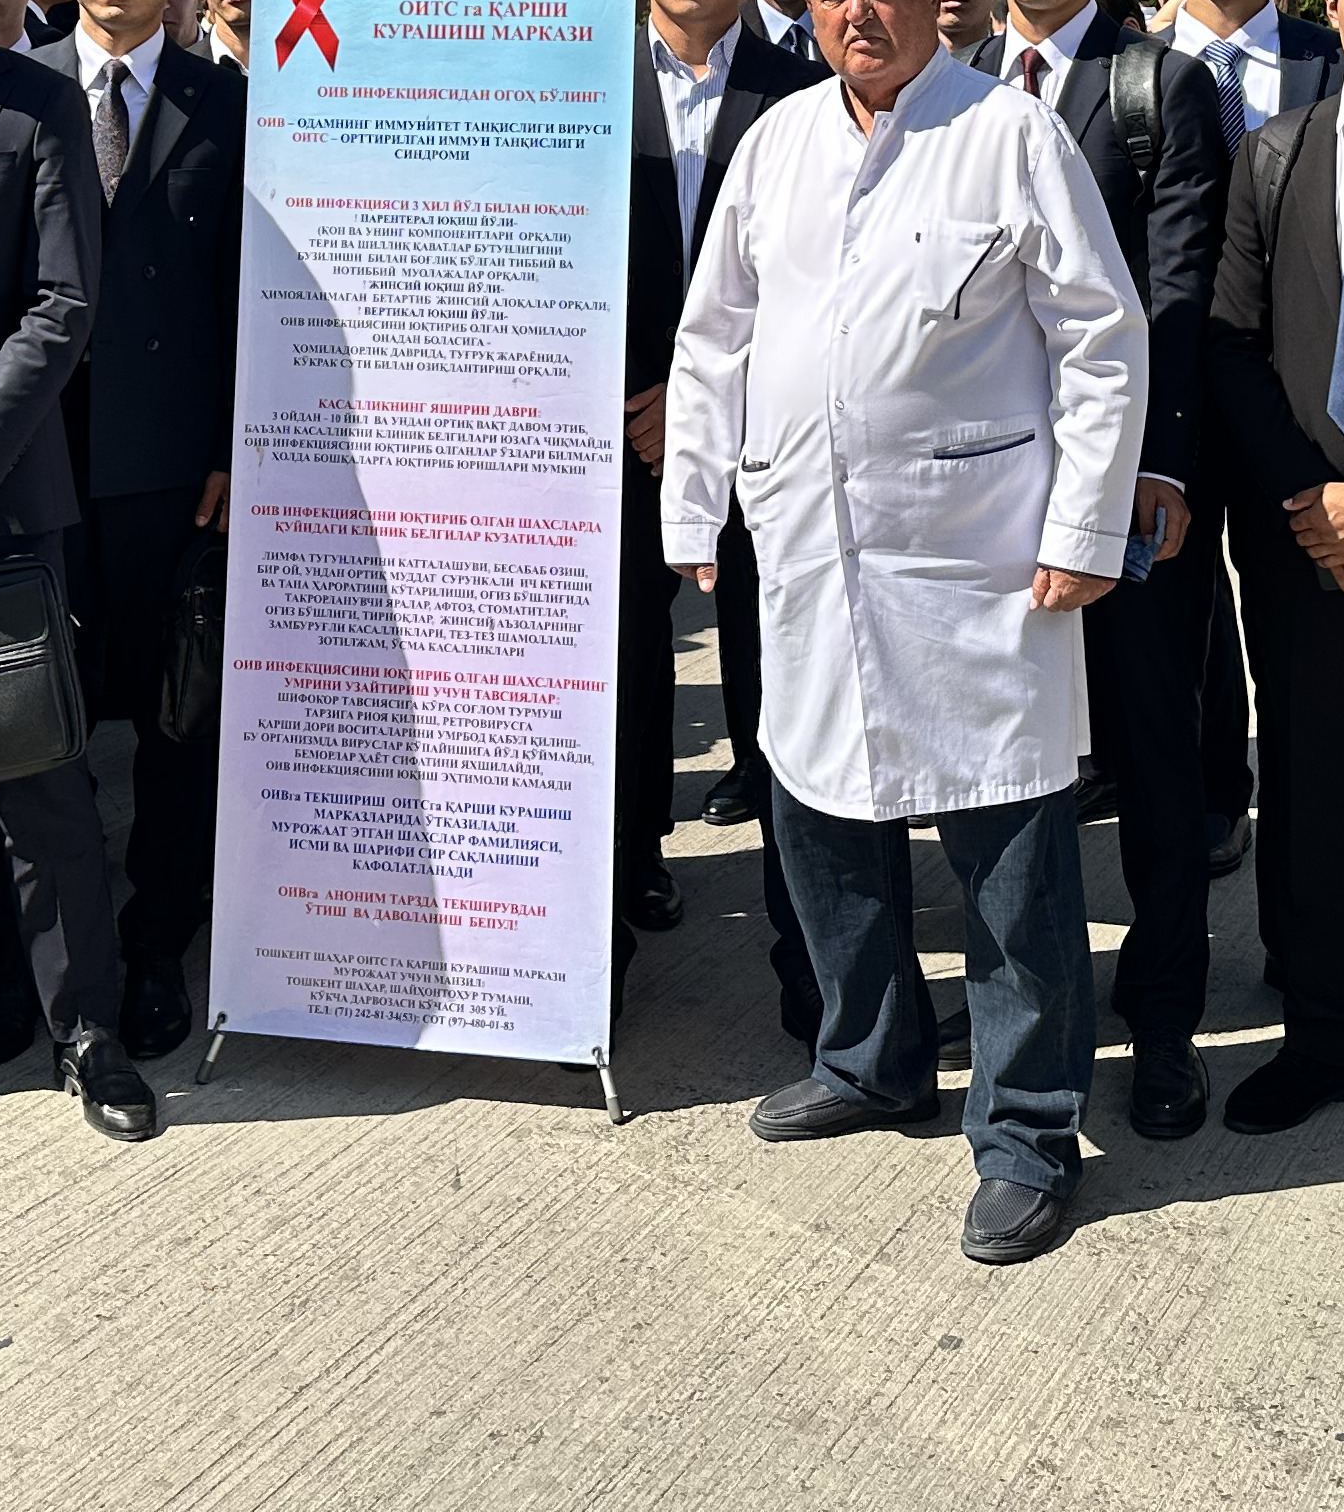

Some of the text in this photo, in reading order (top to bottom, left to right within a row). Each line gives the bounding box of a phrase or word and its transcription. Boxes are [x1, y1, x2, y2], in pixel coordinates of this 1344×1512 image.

[399, 0, 566, 20] ОИТС га ҚАРШИ
[374, 23, 593, 40] КУРАШИШ МАРКАЗИ
[317, 86, 606, 103] ОИВ ИНФЕКЦИЯСИДАН ОГОҲ БЎЛИНГ!
[257, 117, 611, 134] ОИВ ОДАМНИНГ ИММУНИТЕТ ТАНҚИСЛИГИ ВИРУСИ
[292, 132, 585, 150] ОИТС ОРТТИРИЛГАН ИММУН ТАНҚИСЛИГИ
[394, 149, 469, 161] СИНДРОМИ
[285, 197, 312, 207] ОИВ
[316, 198, 409, 211] ИНФЕКЦИЯСИ
[413, 201, 418, 209] 3
[422, 201, 449, 211] ХИЛ
[453, 200, 480, 211] ЙЎЛ
[485, 203, 529, 213] БИЛАН
[430, 403, 489, 415] ЯШИРИН
[251, 505, 279, 515] ОИВ
[470, 515, 514, 527] ОЛГАН
[519, 518, 602, 533] ШАХСЛАРДА
[351, 525, 407, 537] КЛИНИК
[410, 528, 481, 541] БЕЛГИЛАР
[233, 659, 262, 670] ОИВ
[454, 672, 499, 684] ОЛГАН
[284, 677, 341, 690] УМРИНИ
[345, 679, 429, 696] УЗАЙТИРИШ
[432, 687, 470, 698] УЧУН
[261, 788, 300, 801] ОИВга
[304, 791, 385, 807] ТЕКШИРИШ
[392, 797, 441, 810] ОИТСга
[499, 805, 571, 820] КУРАШИШ
[272, 821, 348, 836] МУРОЖААТ
[350, 827, 393, 839] ЭТГАН
[398, 830, 465, 844] ШАХСЛАР
[289, 838, 329, 851] ИСМИ
[333, 842, 349, 852] ВА
[353, 843, 414, 857] ШАРИФИ
[418, 847, 445, 859] СИР
[278, 886, 318, 898] ОИВга
[325, 889, 385, 903] АНОНИМ
[389, 894, 438, 908] ТАРЗДА
[305, 902, 518, 930] ЎТИШ ВА ДАВОЛАНИШ БЕПУЛ!
